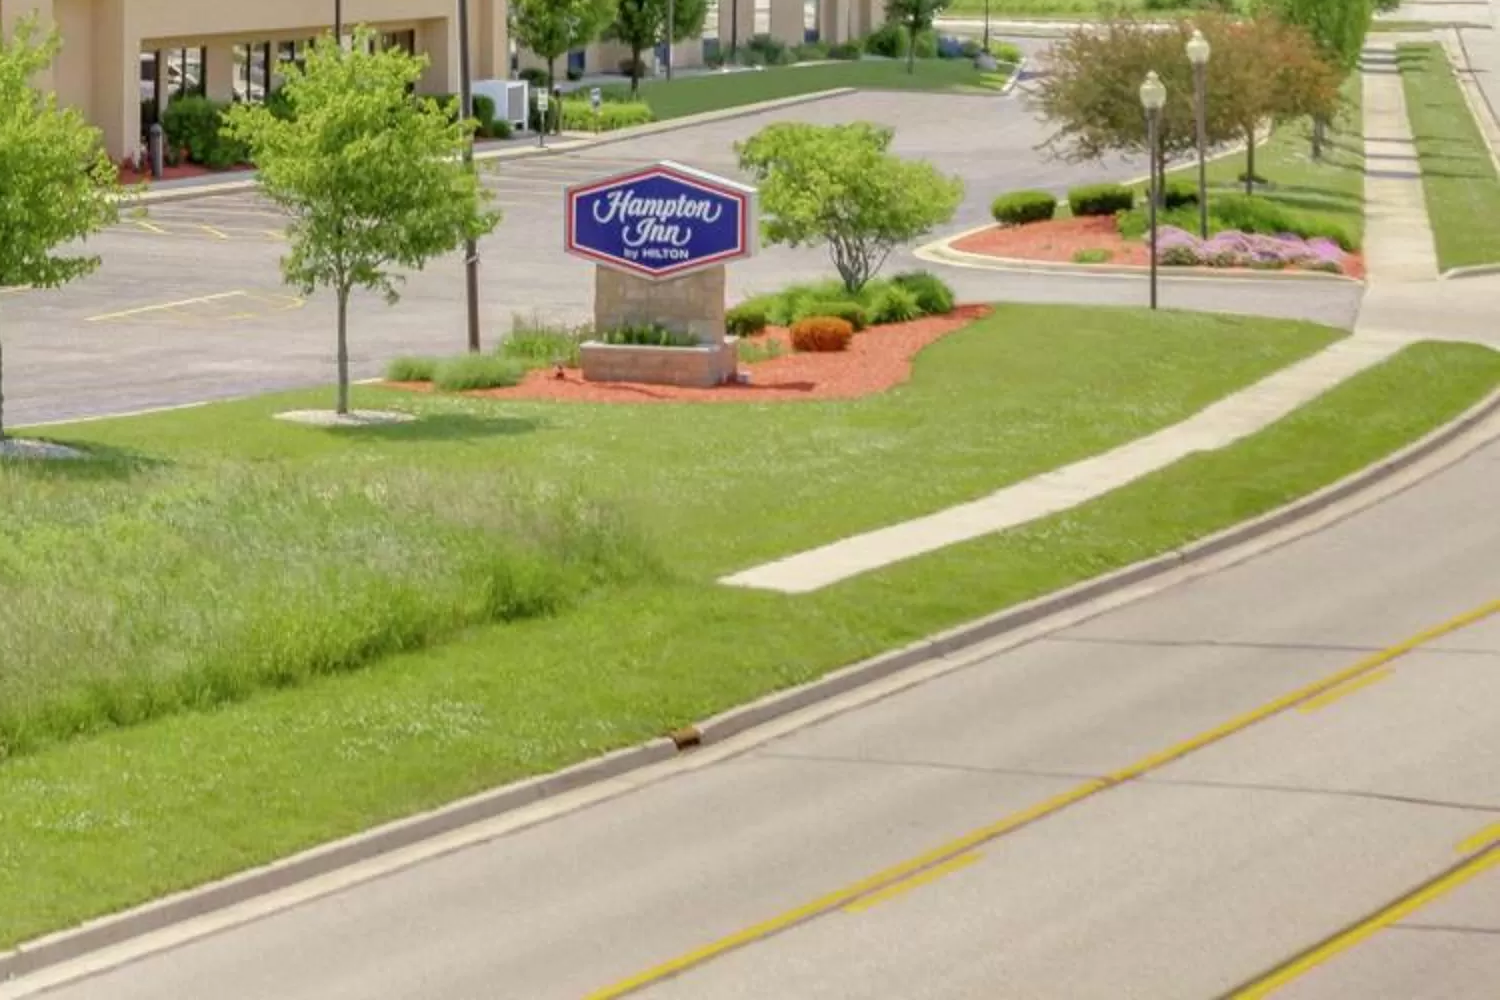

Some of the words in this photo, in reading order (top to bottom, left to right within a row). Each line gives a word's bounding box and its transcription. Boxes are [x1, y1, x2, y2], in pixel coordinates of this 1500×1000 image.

[593, 190, 722, 223] Hampton
[622, 217, 691, 246] Inn
[624, 248, 638, 260] by
[642, 248, 689, 259] HILTON
